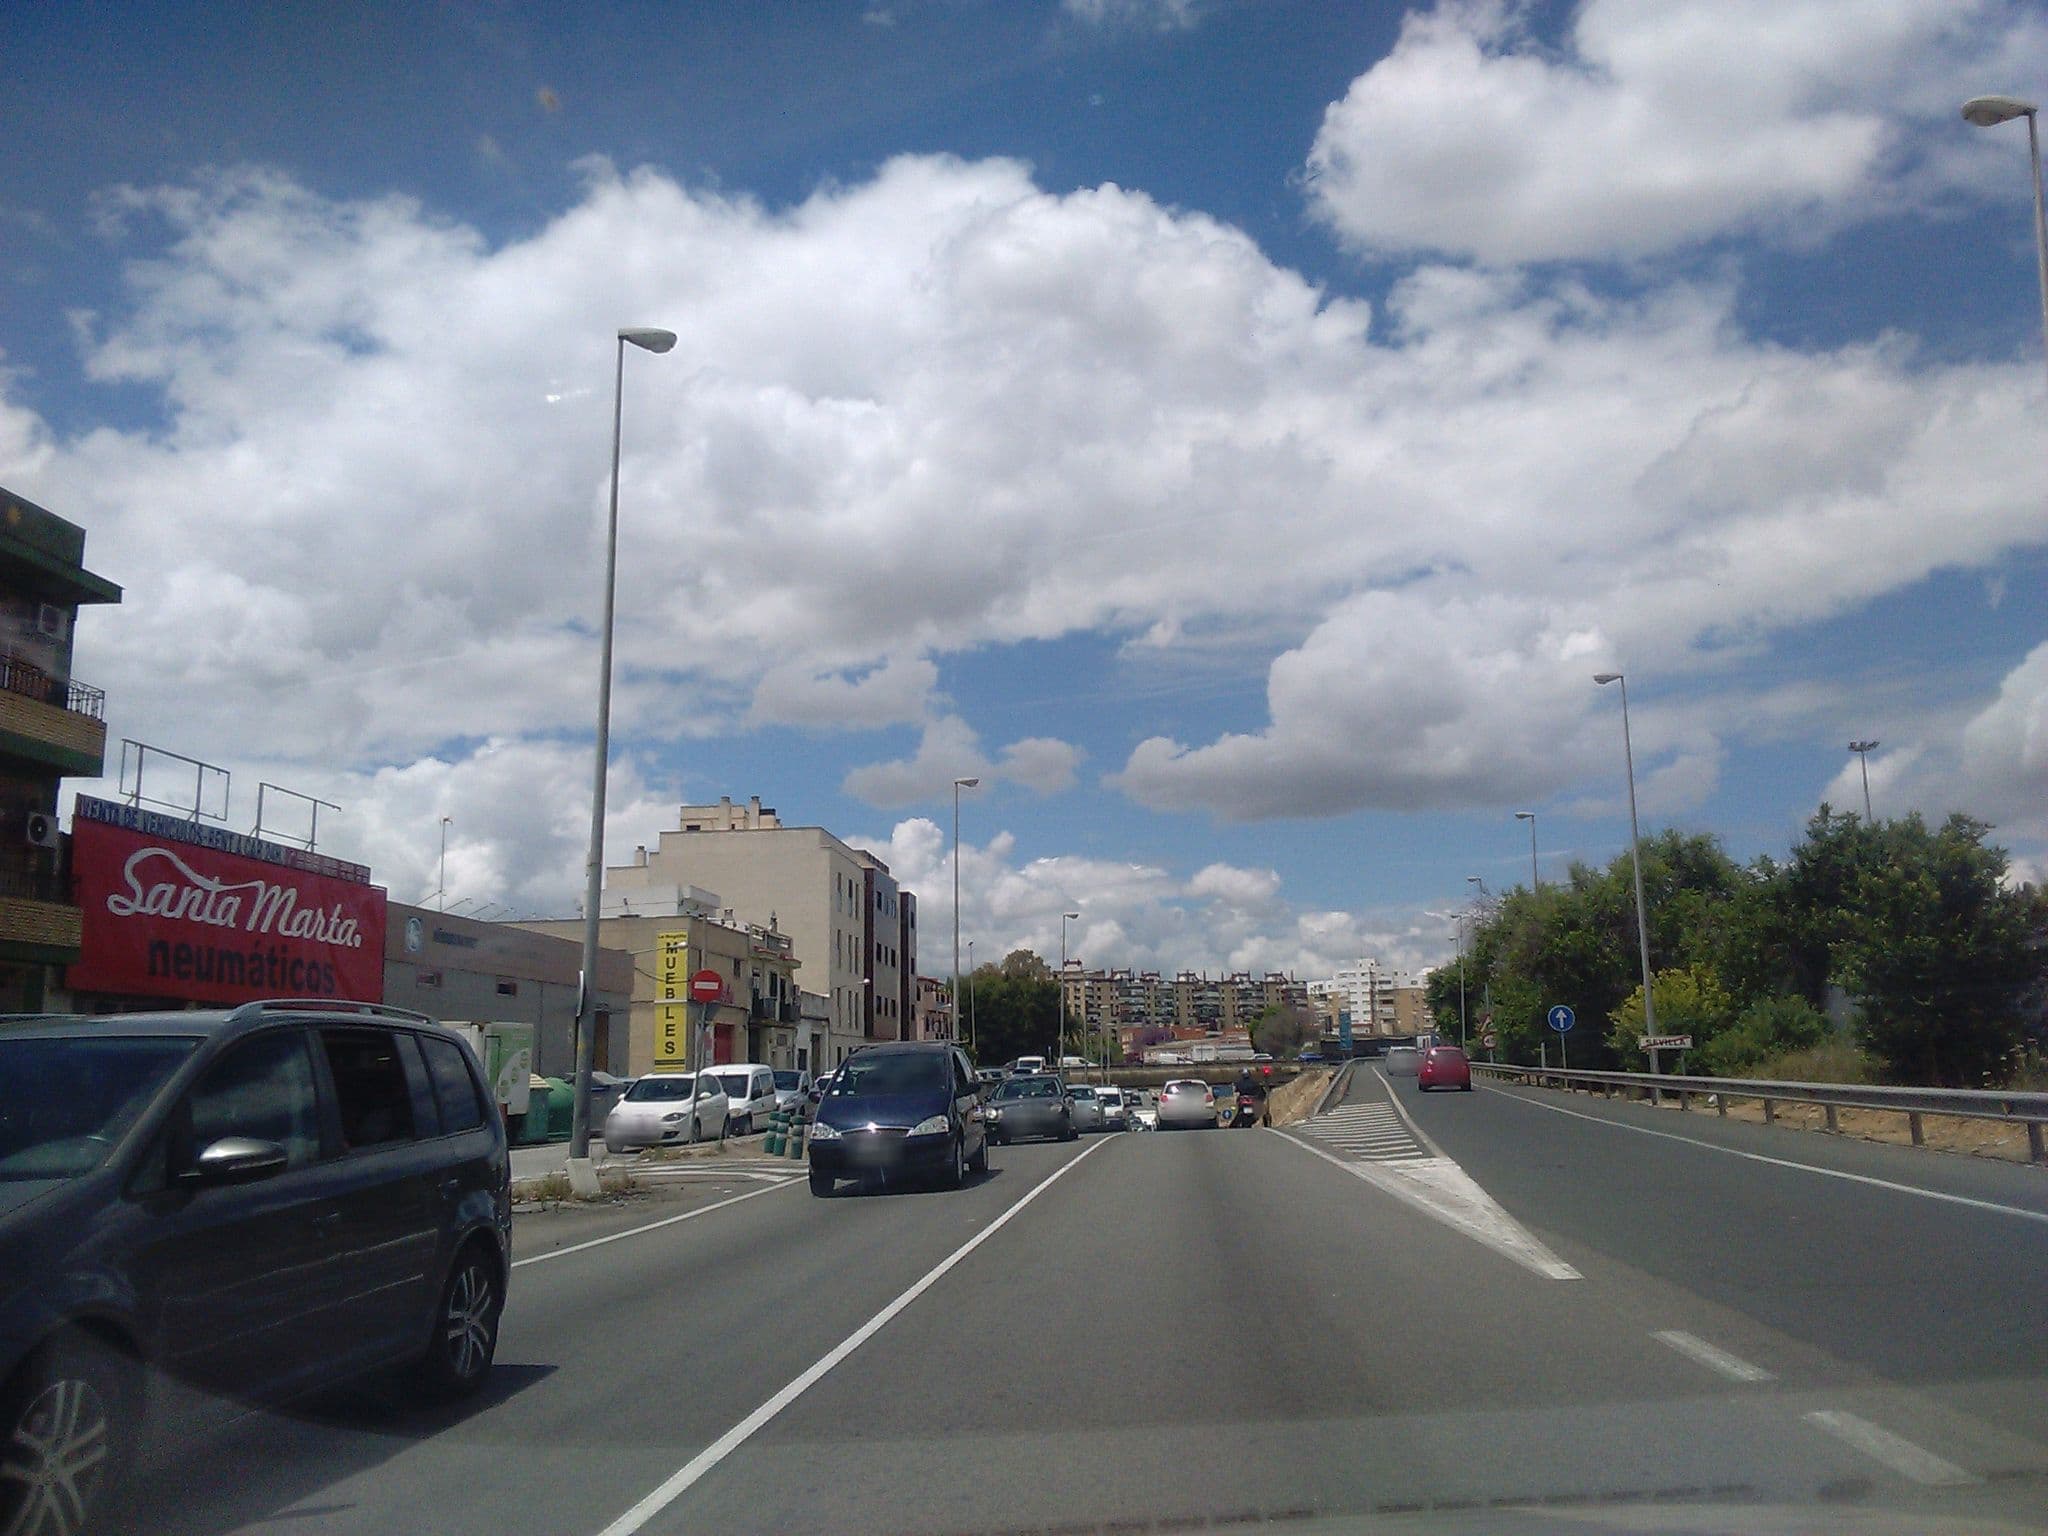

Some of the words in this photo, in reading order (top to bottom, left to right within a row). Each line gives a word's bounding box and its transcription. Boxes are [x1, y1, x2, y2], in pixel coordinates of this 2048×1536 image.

[107, 847, 240, 928] Santa
[148, 938, 336, 995] neumáticos
[664, 941, 678, 1055] MUEBLES
[1645, 1038, 1686, 1046] SEVILLA
